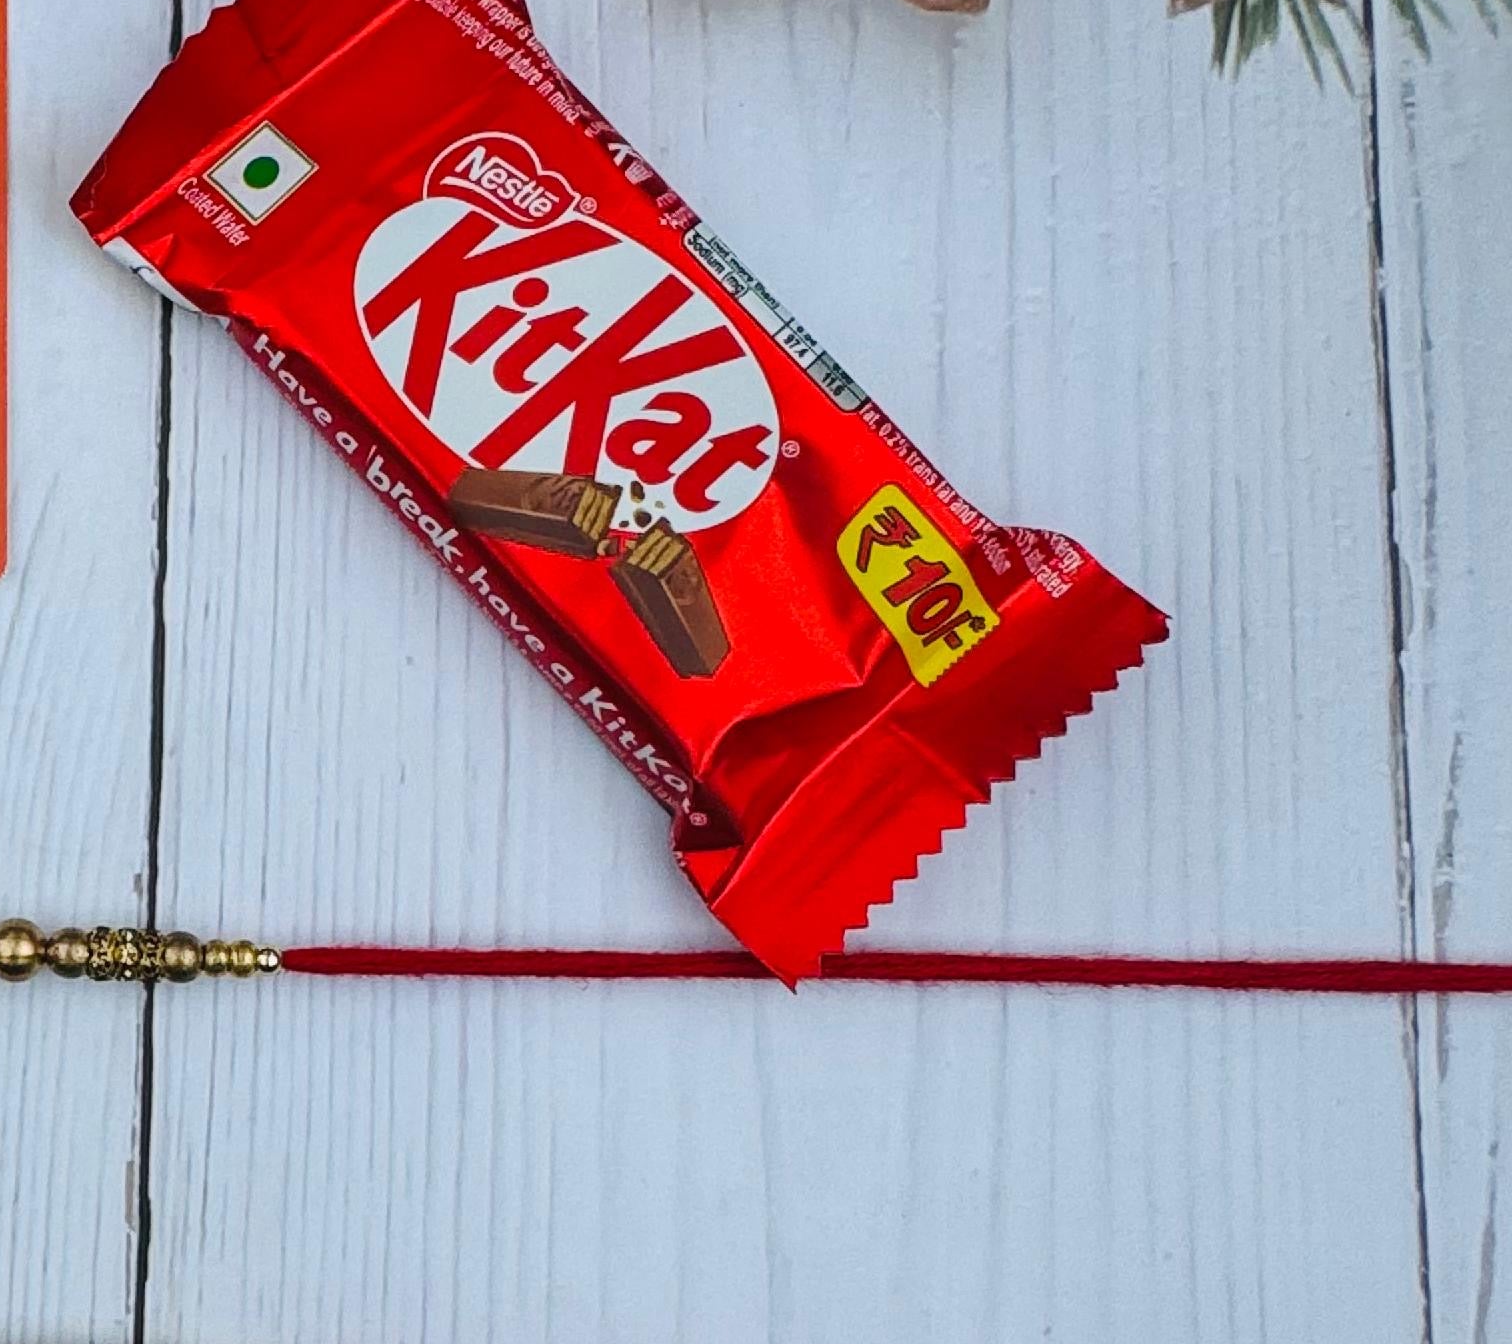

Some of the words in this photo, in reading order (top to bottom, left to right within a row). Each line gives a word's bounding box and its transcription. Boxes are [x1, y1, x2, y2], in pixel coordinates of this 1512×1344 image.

[452, 6, 495, 49] keeping
[488, 38, 514, 59] our
[506, 48, 542, 85] future
[536, 76, 554, 97] in
[515, 24, 532, 40] is
[177, 177, 225, 219] Coated
[211, 209, 250, 246] Wafer
[688, 231, 726, 274] Sodium
[363, 212, 773, 513] KitKat
[253, 333, 332, 427] Have
[335, 431, 359, 455] a
[366, 447, 464, 574] break,
[468, 566, 546, 653] have
[550, 662, 575, 684] a
[860, 403, 879, 429] fat,
[905, 451, 938, 486] trans
[934, 479, 956, 504] fat
[950, 497, 978, 526] and
